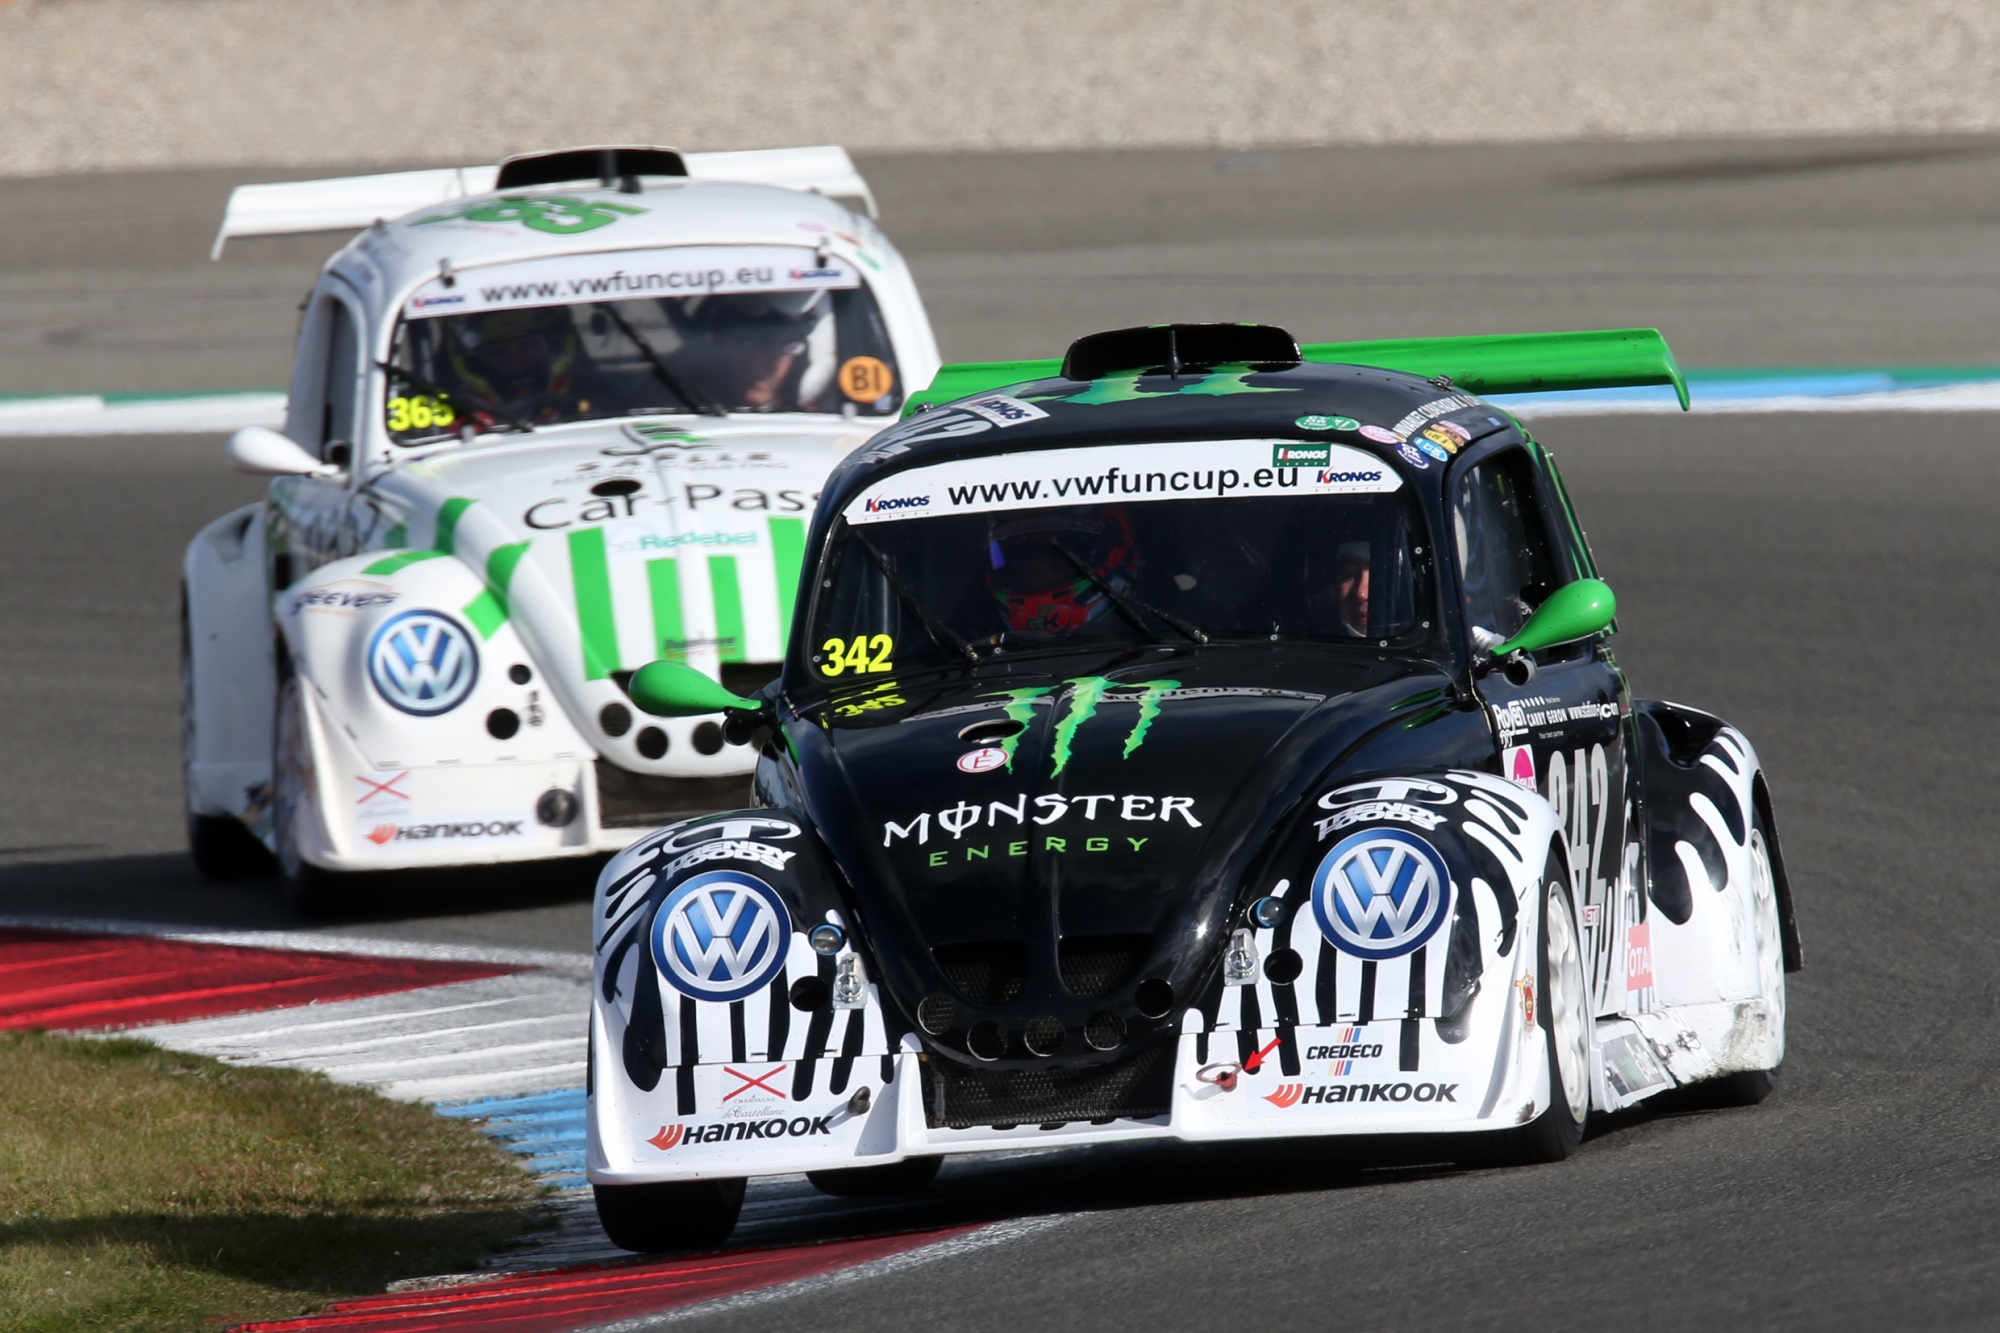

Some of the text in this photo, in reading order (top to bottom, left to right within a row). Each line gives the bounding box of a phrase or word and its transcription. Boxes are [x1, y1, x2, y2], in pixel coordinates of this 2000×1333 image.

[481, 265, 773, 304] www.vwfuncup.eu
[388, 394, 454, 431] 365
[1277, 446, 1328, 461] KRONOS
[948, 465, 1298, 506] www.vwfuncup.eu
[1316, 466, 1382, 484] KRONOS
[865, 493, 931, 512] KRONOS
[820, 633, 894, 678] 342
[1313, 802, 1449, 830] TRENDY
[1318, 810, 1436, 842] FOODS
[665, 850, 785, 882] FOODS
[929, 837, 1149, 867] ENERGY
[1306, 1043, 1383, 1060] CREDECO
